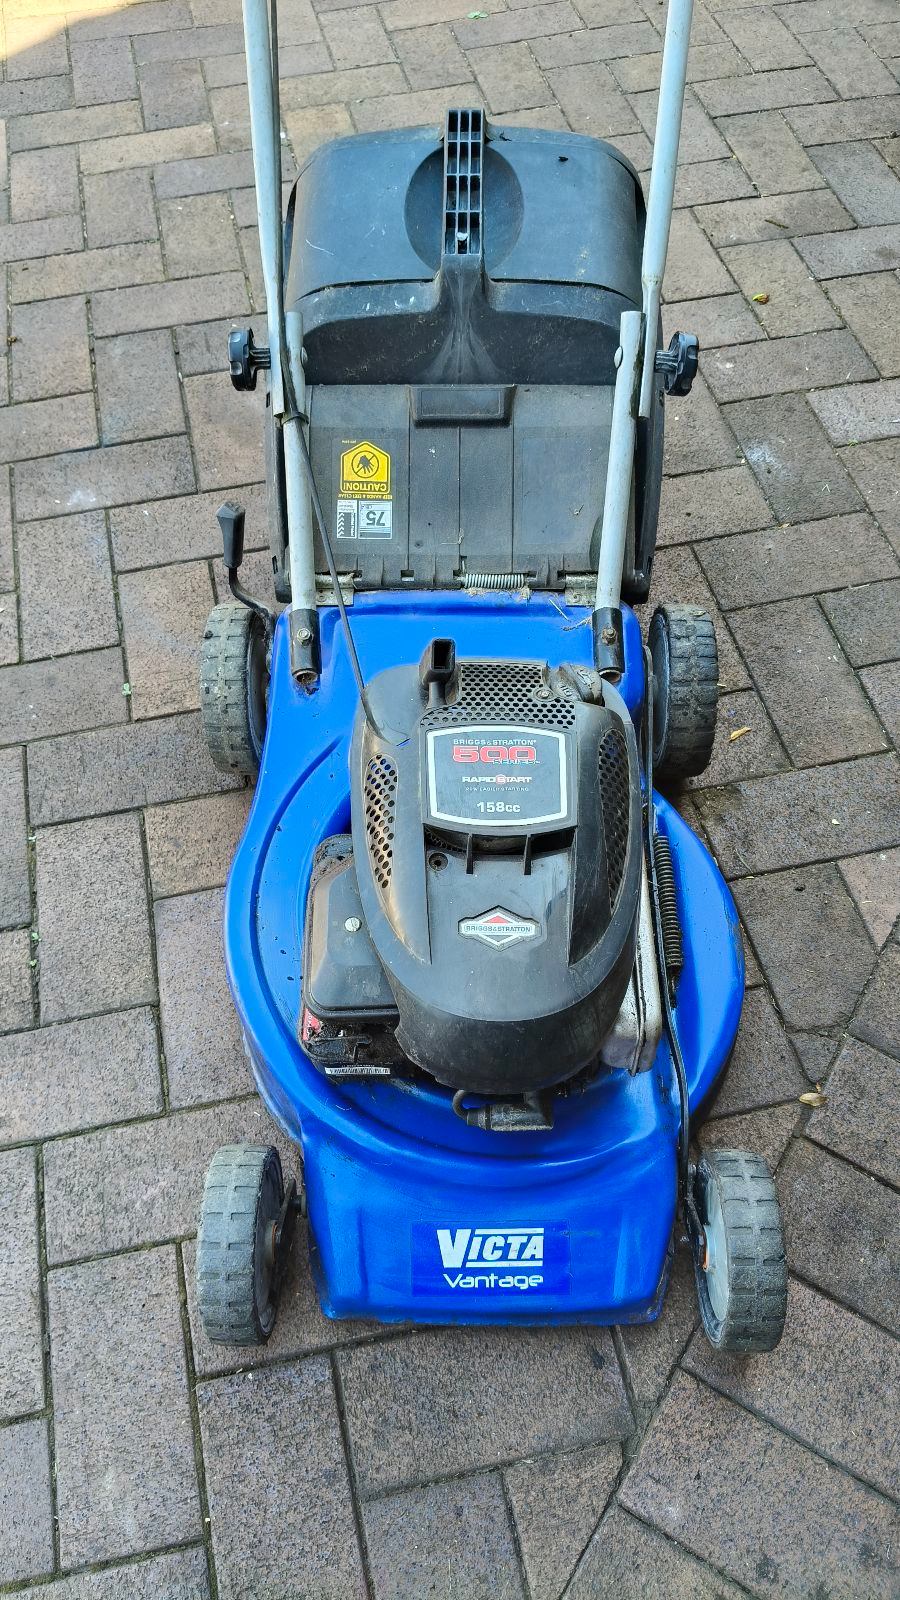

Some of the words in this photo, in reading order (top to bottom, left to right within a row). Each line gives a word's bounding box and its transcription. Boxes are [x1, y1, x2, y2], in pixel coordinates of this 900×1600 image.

[343, 482, 387, 491] CAUTION!
[365, 510, 386, 527] 75
[452, 745, 537, 763] 500
[476, 801, 521, 813] 158cc
[436, 1228, 545, 1268] VICTA
[442, 1273, 544, 1290] Vantage
